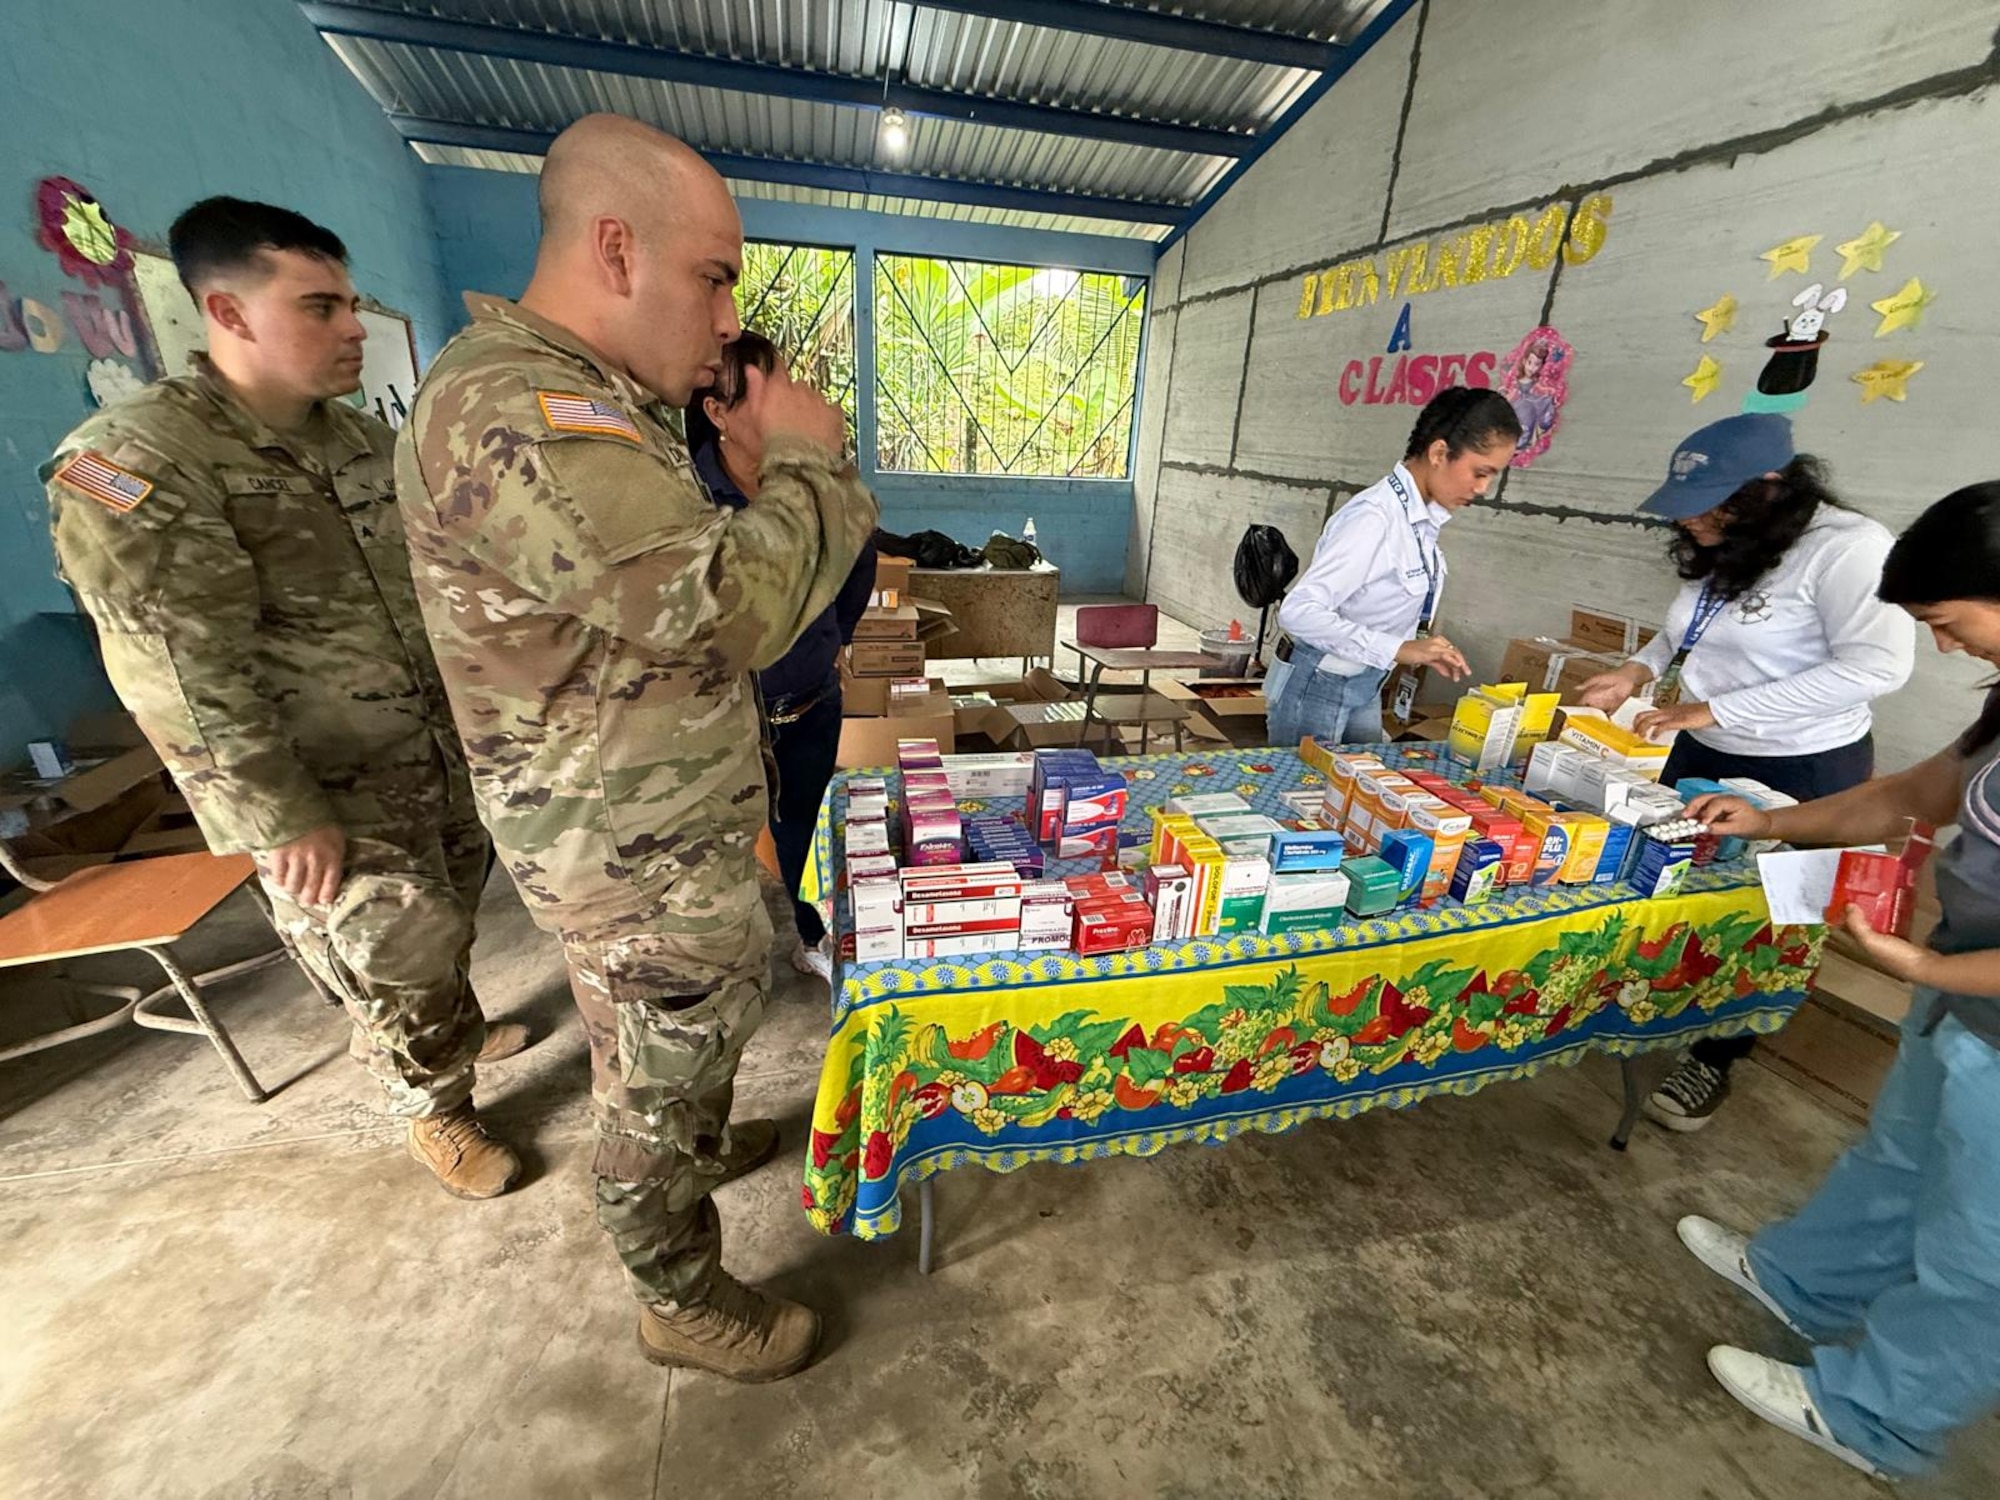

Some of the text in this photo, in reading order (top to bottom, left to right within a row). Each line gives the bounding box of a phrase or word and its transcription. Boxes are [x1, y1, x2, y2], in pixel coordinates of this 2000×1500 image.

[1387, 302, 1412, 353] A
[1339, 351, 1496, 406] CLASES
[1571, 730, 1610, 759] VITAMIN C
[1542, 844, 1562, 853] FLU
